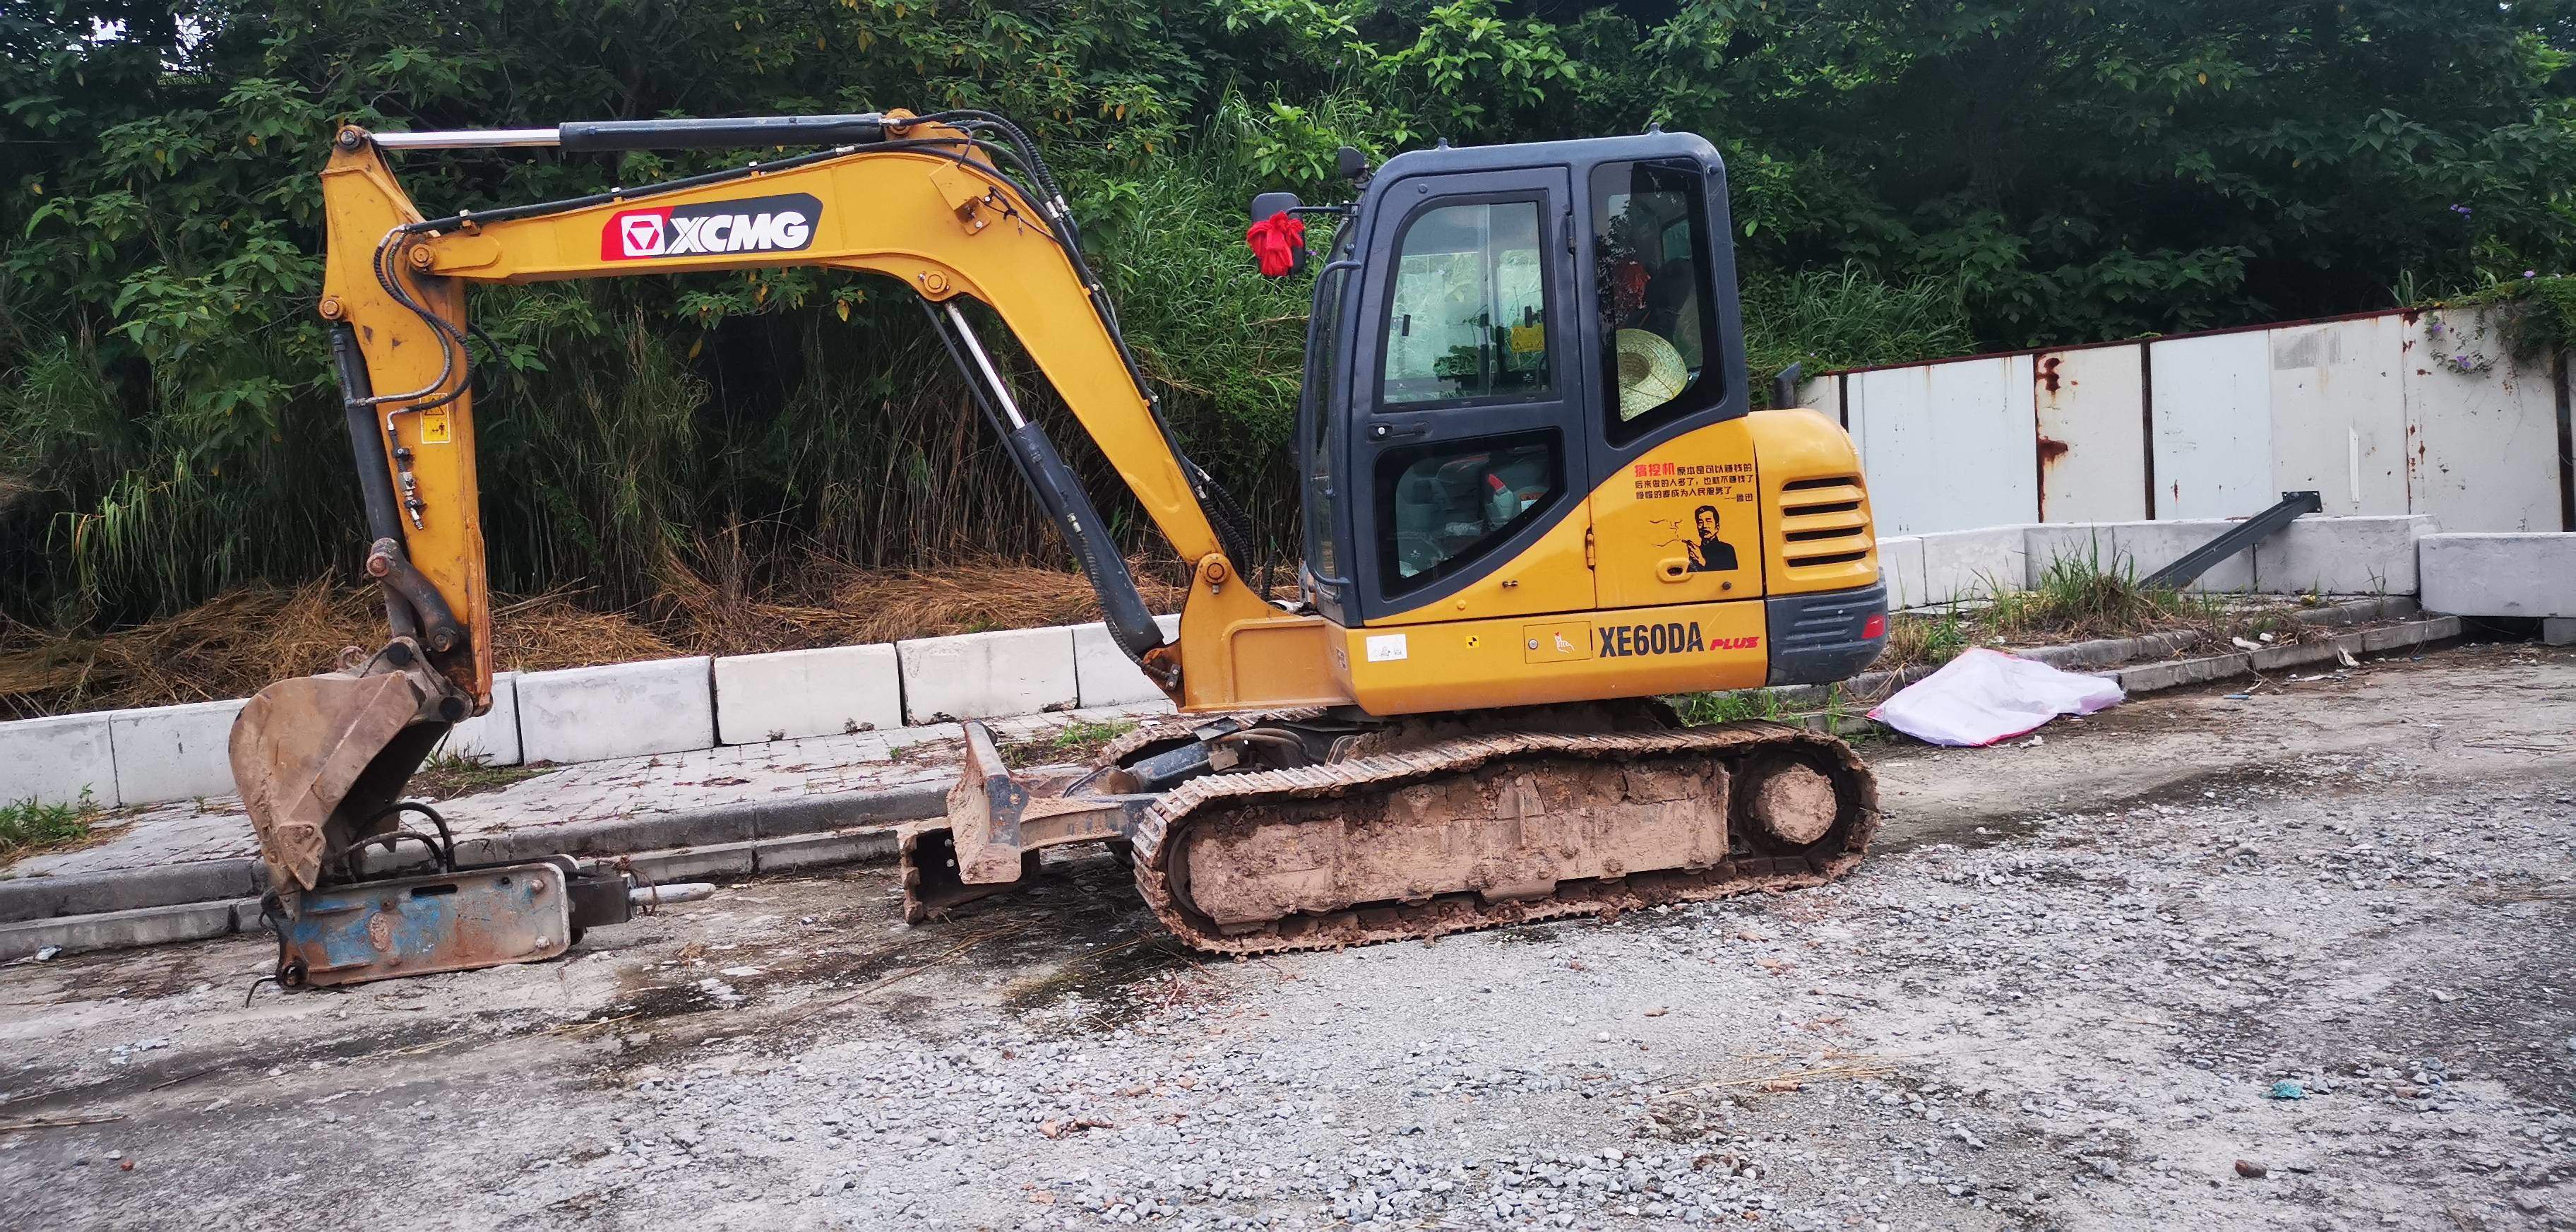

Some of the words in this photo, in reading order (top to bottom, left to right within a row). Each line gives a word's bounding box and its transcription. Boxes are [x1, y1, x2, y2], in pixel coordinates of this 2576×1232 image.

[664, 211, 809, 254] XCMG
[1598, 622, 1705, 658] XE60DA
[1710, 636, 1760, 651] PLUS
